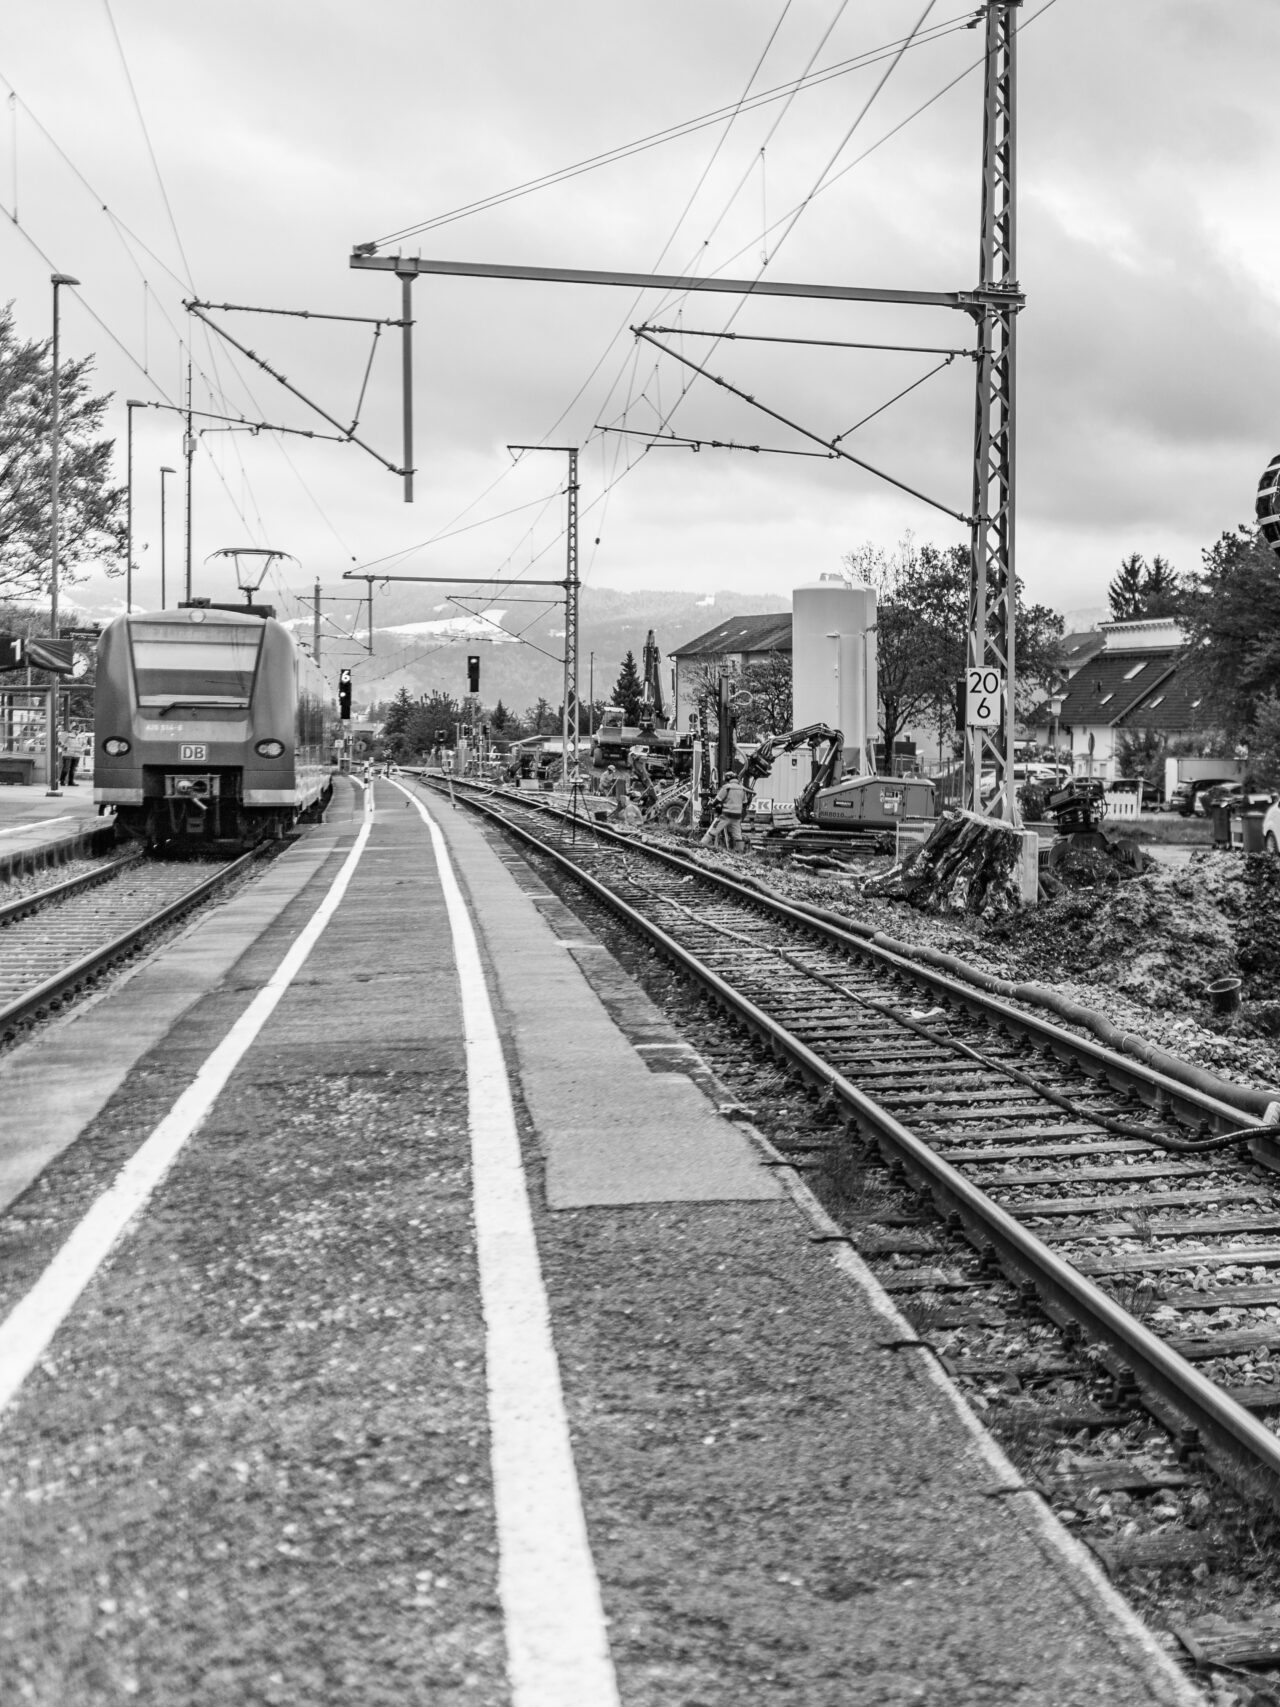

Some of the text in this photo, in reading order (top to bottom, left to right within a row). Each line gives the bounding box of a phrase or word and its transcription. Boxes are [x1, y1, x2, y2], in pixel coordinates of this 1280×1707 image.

[10, 639, 21, 662] 1
[341, 670, 350, 683] 6
[969, 672, 999, 694] 20
[977, 697, 991, 719] 6
[183, 746, 204, 759] DB
